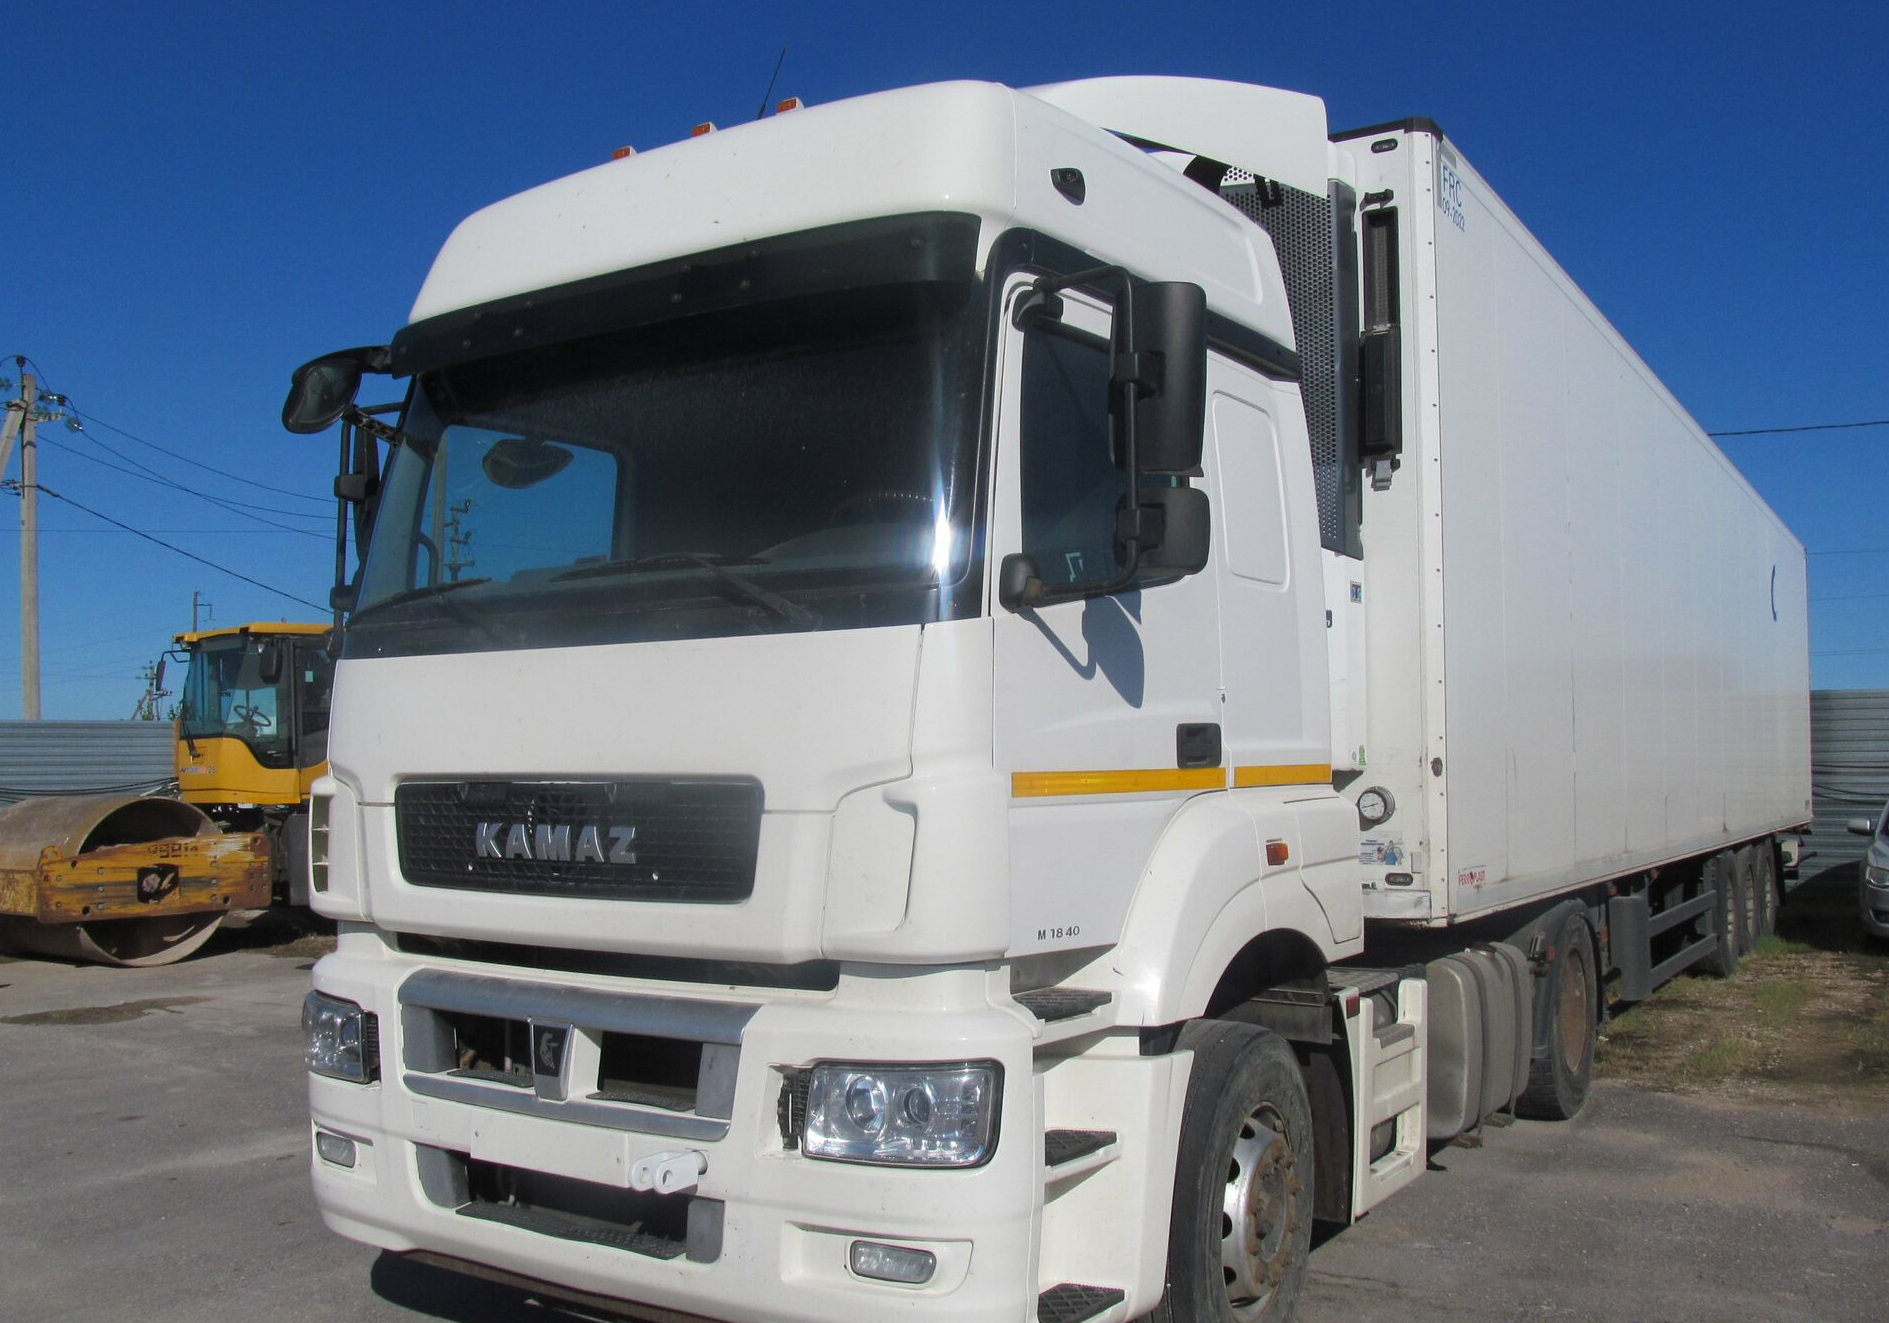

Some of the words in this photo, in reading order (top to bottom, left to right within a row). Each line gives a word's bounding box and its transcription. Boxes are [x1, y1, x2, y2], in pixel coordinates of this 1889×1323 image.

[1442, 165, 1463, 208] FRC
[476, 822, 637, 864] KAMAZ
[1037, 929, 1046, 941] M
[1050, 925, 1080, 939] 1840
